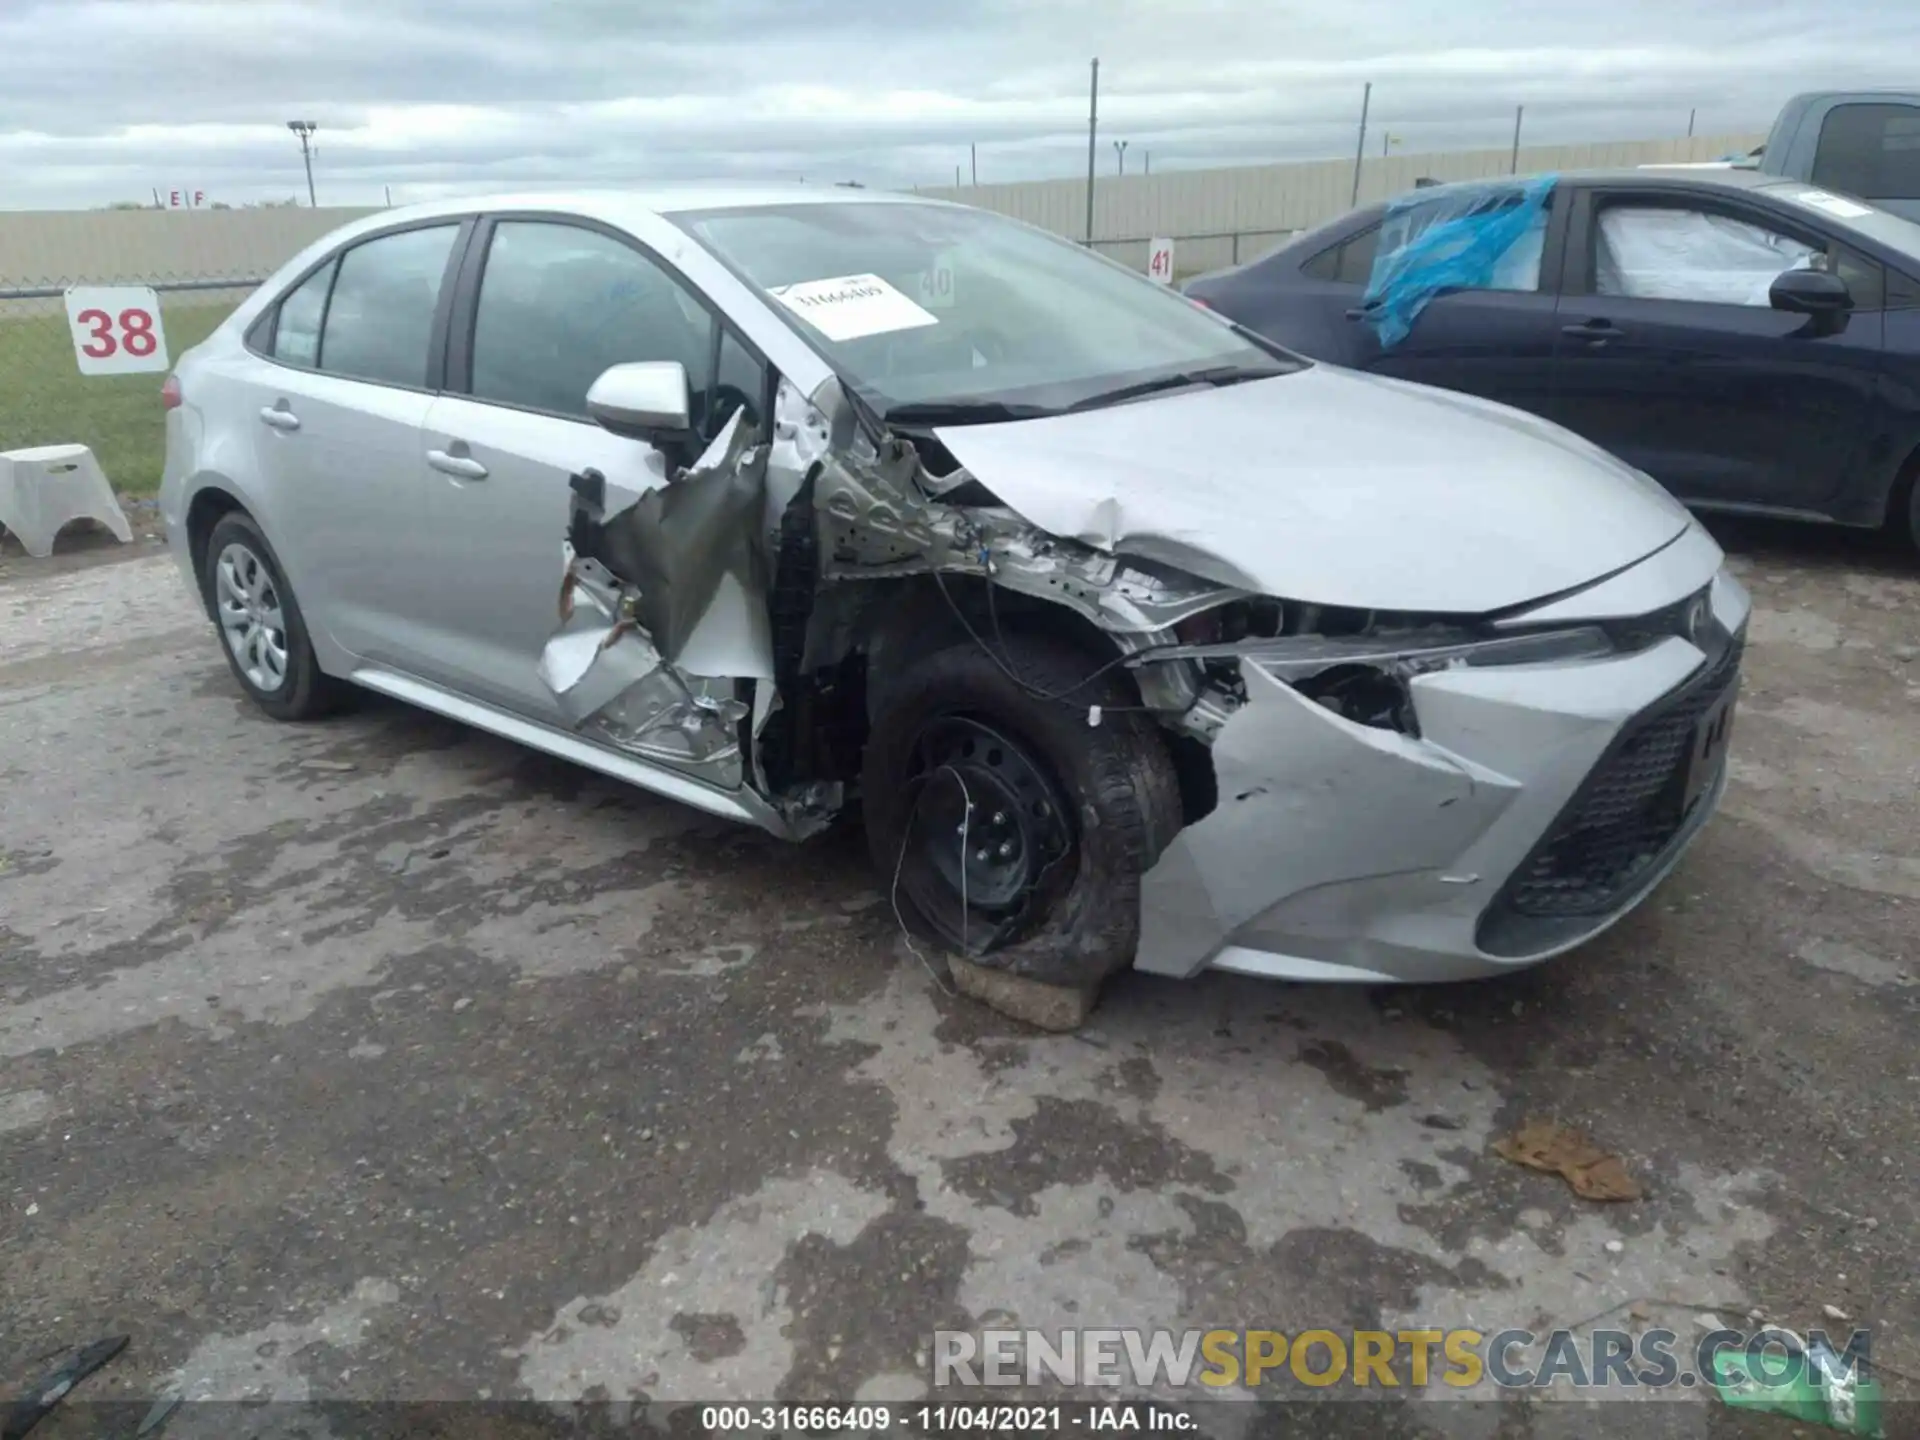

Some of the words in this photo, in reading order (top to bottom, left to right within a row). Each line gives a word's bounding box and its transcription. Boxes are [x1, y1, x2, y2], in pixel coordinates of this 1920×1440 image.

[171, 191, 179, 206] E
[195, 191, 203, 206] F
[1152, 249, 1169, 276] 41
[77, 308, 157, 358] 38
